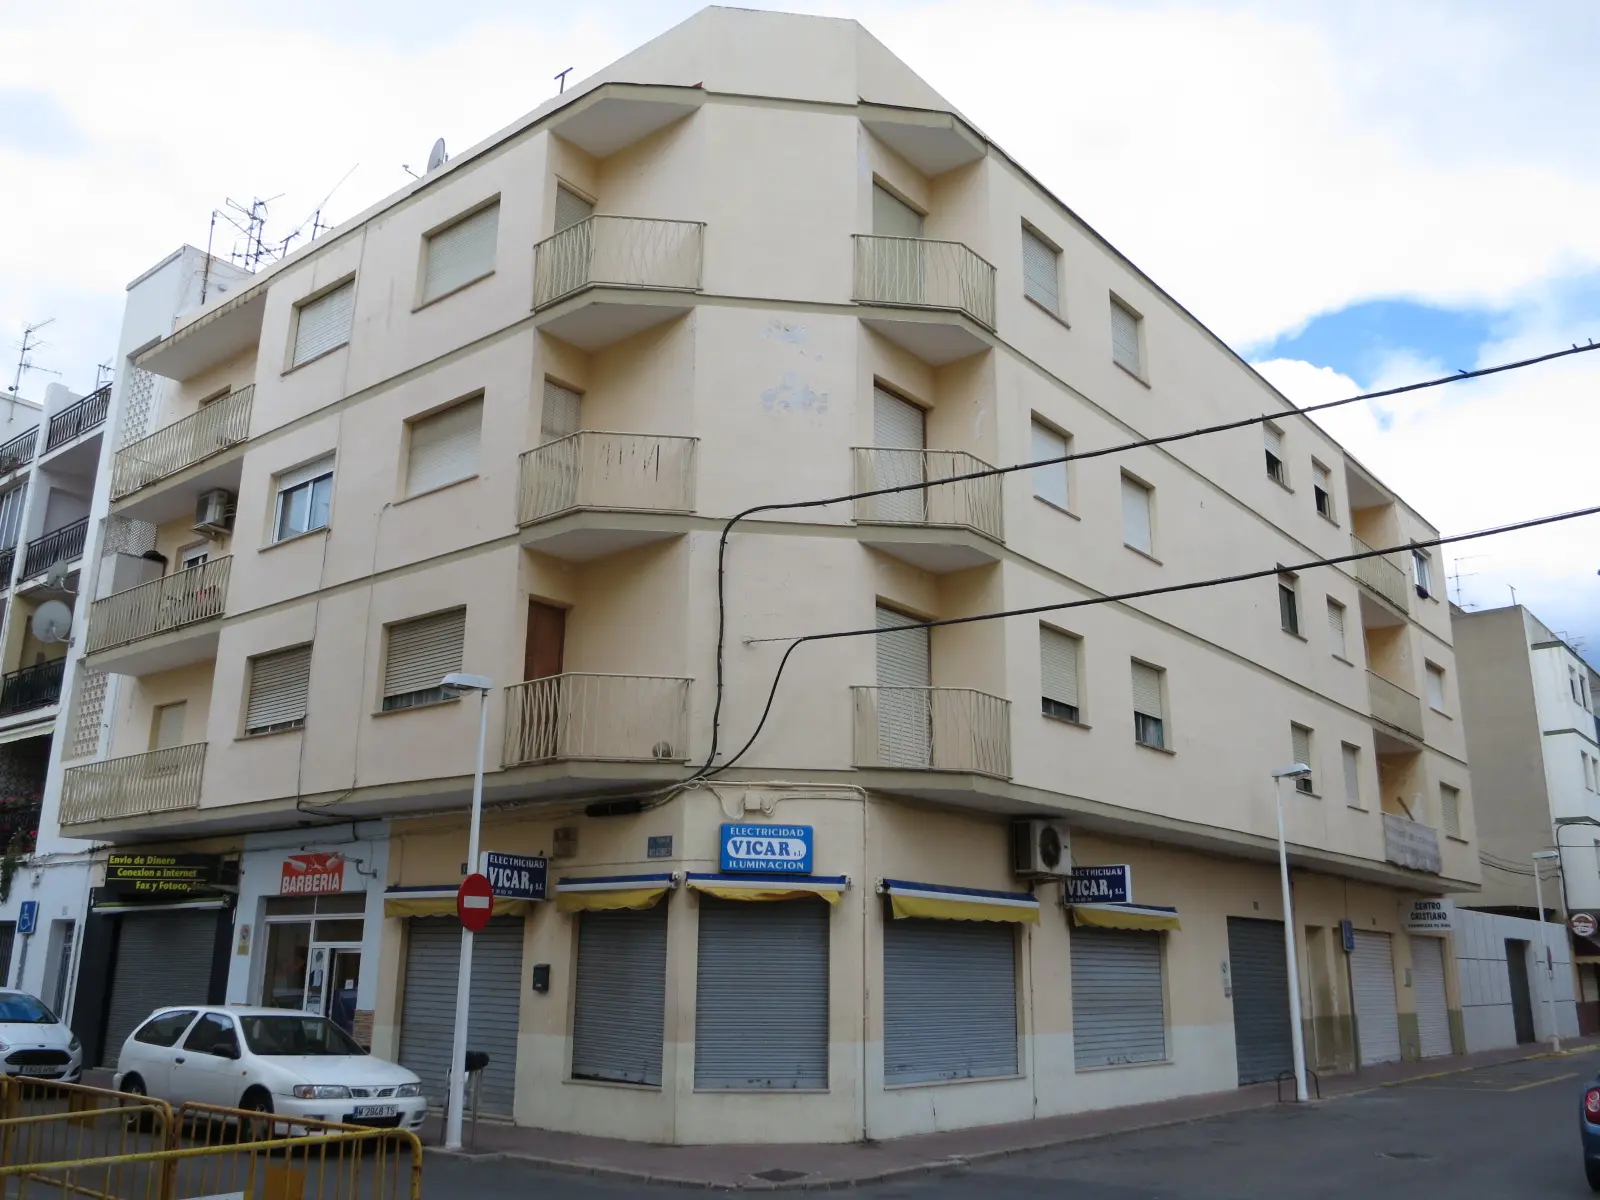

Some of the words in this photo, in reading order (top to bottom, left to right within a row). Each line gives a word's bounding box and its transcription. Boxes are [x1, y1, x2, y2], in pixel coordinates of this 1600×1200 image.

[730, 827, 805, 837] ELECTRICIDAD
[731, 840, 791, 857] VICAR
[147, 856, 176, 865] Dinero
[489, 854, 545, 869] ELECTRICIDAD
[729, 859, 804, 870] ILUMINACION
[117, 867, 154, 877] Conexion
[1071, 868, 1123, 877] LECTRICIDAD
[136, 881, 150, 889] Fax
[151, 882, 158, 892] y
[281, 872, 340, 893] BARBERIA
[1414, 901, 1441, 910] CENTRO
[1410, 911, 1447, 920] CRISTIANO
